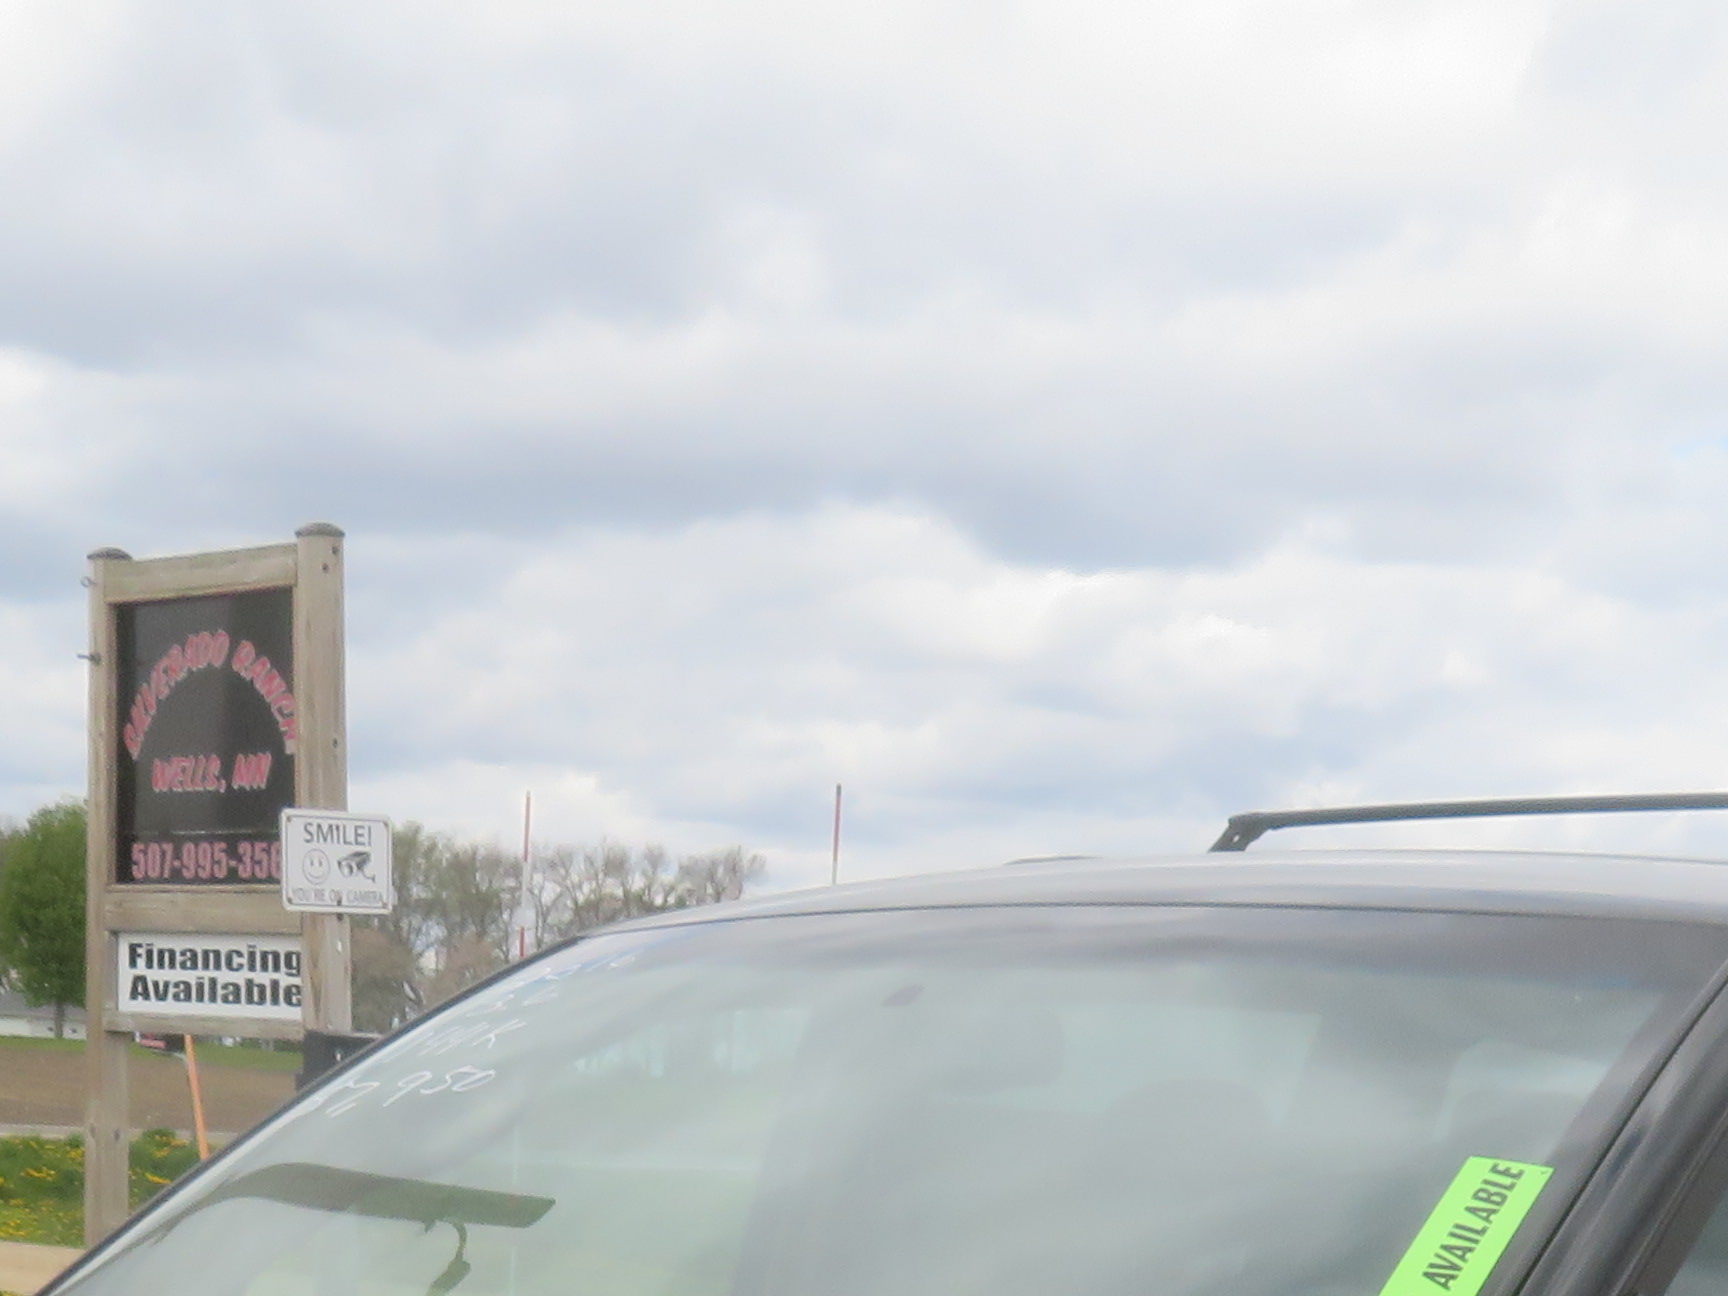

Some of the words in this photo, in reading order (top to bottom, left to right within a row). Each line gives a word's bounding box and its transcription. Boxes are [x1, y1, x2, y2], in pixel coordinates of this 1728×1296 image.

[151, 754, 227, 793] WELLS,
[231, 751, 272, 790] MN
[303, 822, 372, 847] SMILE!
[128, 942, 302, 977] Financing
[129, 974, 302, 1008] Available
[1422, 1163, 1525, 1291] AVAILABLE
